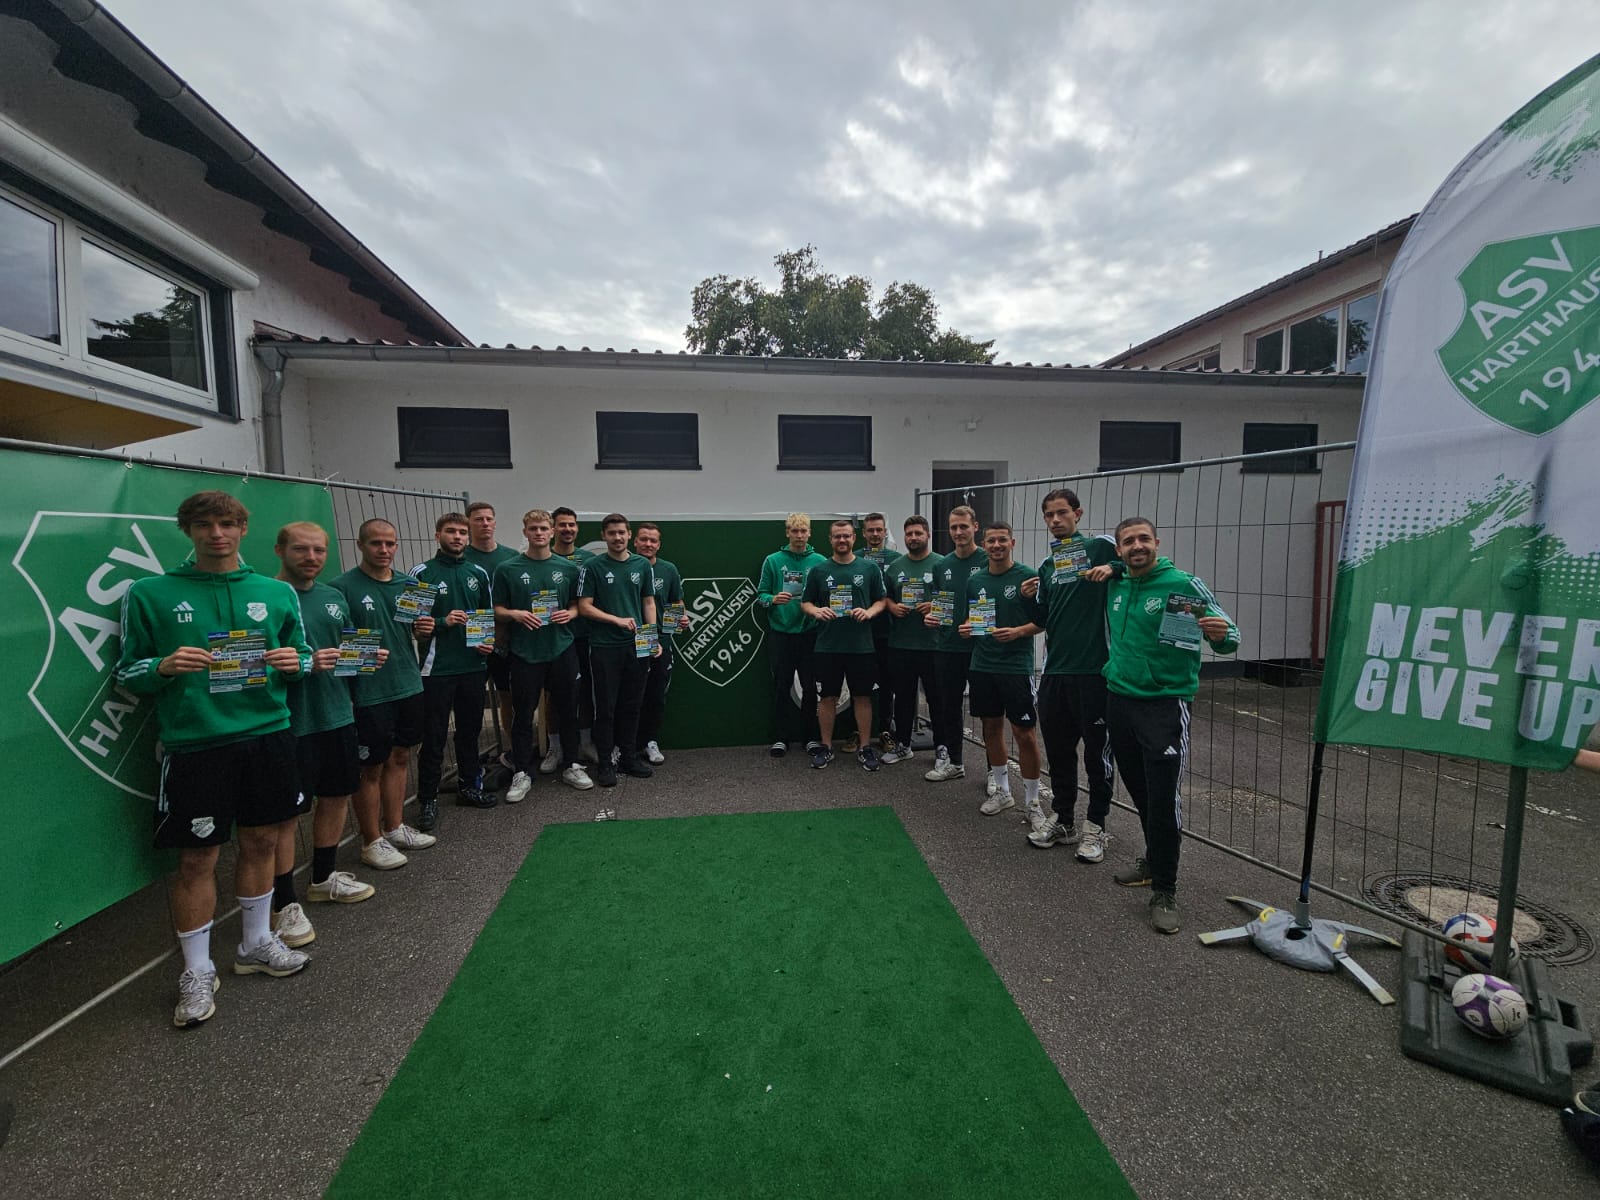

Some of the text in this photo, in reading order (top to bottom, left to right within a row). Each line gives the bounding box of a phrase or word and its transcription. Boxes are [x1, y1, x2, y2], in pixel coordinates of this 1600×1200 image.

[1470, 236, 1574, 340] ASV
[58, 522, 165, 673] ASV
[177, 613, 193, 623] LH
[683, 585, 756, 661] HARTHAUSEN
[685, 581, 724, 633] ASV
[709, 630, 752, 672] 1946
[1366, 602, 1600, 684] NEVER
[1354, 658, 1600, 749] GIVE UP
